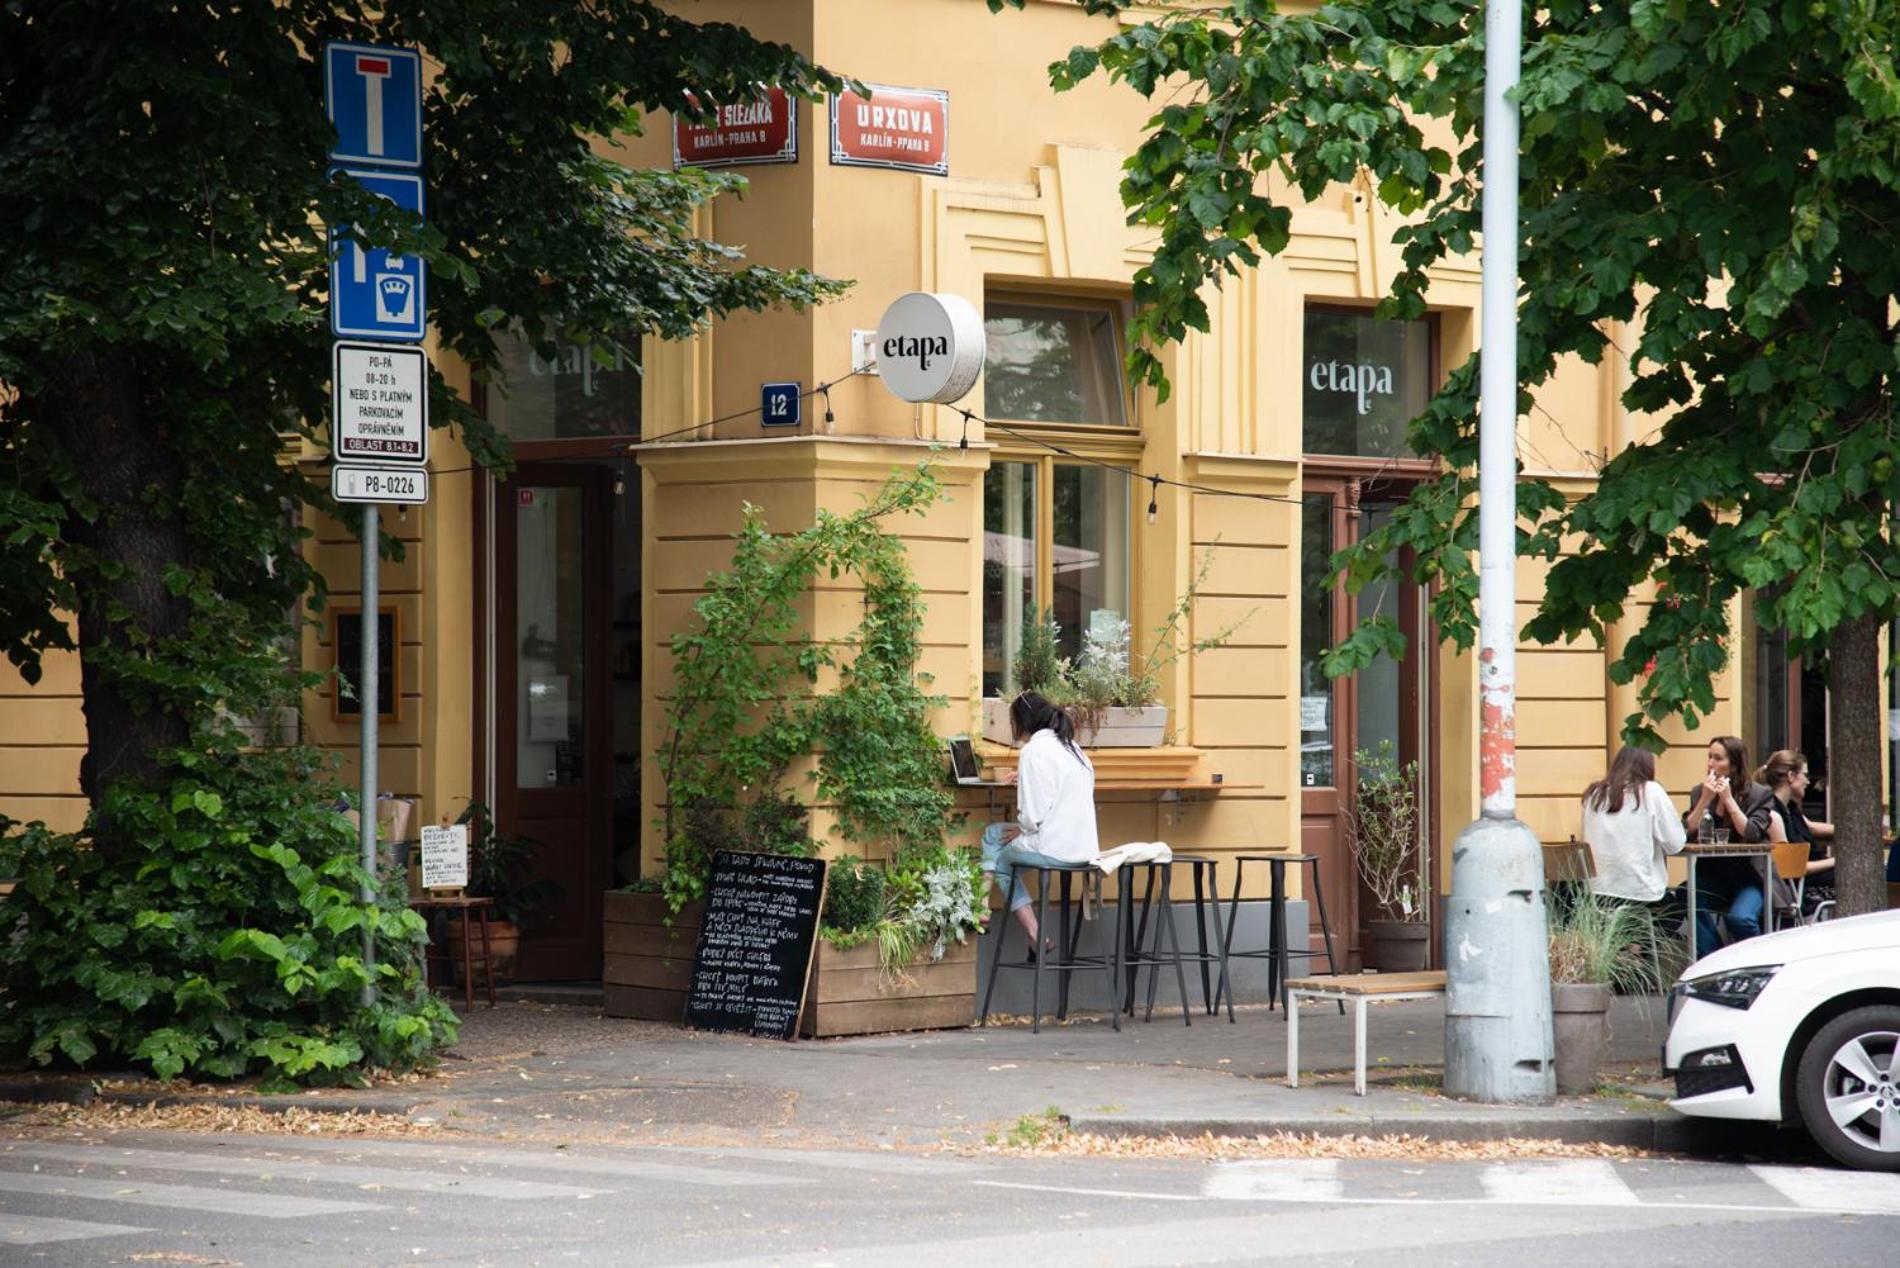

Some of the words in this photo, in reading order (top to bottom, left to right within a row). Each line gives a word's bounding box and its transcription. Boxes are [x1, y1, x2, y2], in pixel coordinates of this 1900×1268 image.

[857, 104, 933, 134] URXOVA
[759, 130, 766, 143] 8
[883, 335, 948, 371] etapa
[369, 355, 392, 368] PO-PÁ
[366, 372, 388, 385] 08-20
[1310, 359, 1393, 415] etapa
[349, 388, 369, 401] NEBO
[372, 390, 377, 401] S
[379, 388, 413, 403] PLATNÝM
[359, 405, 404, 419] PARKOVACÍM
[771, 393, 787, 416] 12
[358, 421, 405, 436] OPRÁVNĚNÍM
[349, 438, 383, 451] OBLAST
[365, 475, 415, 494] P8-0226
